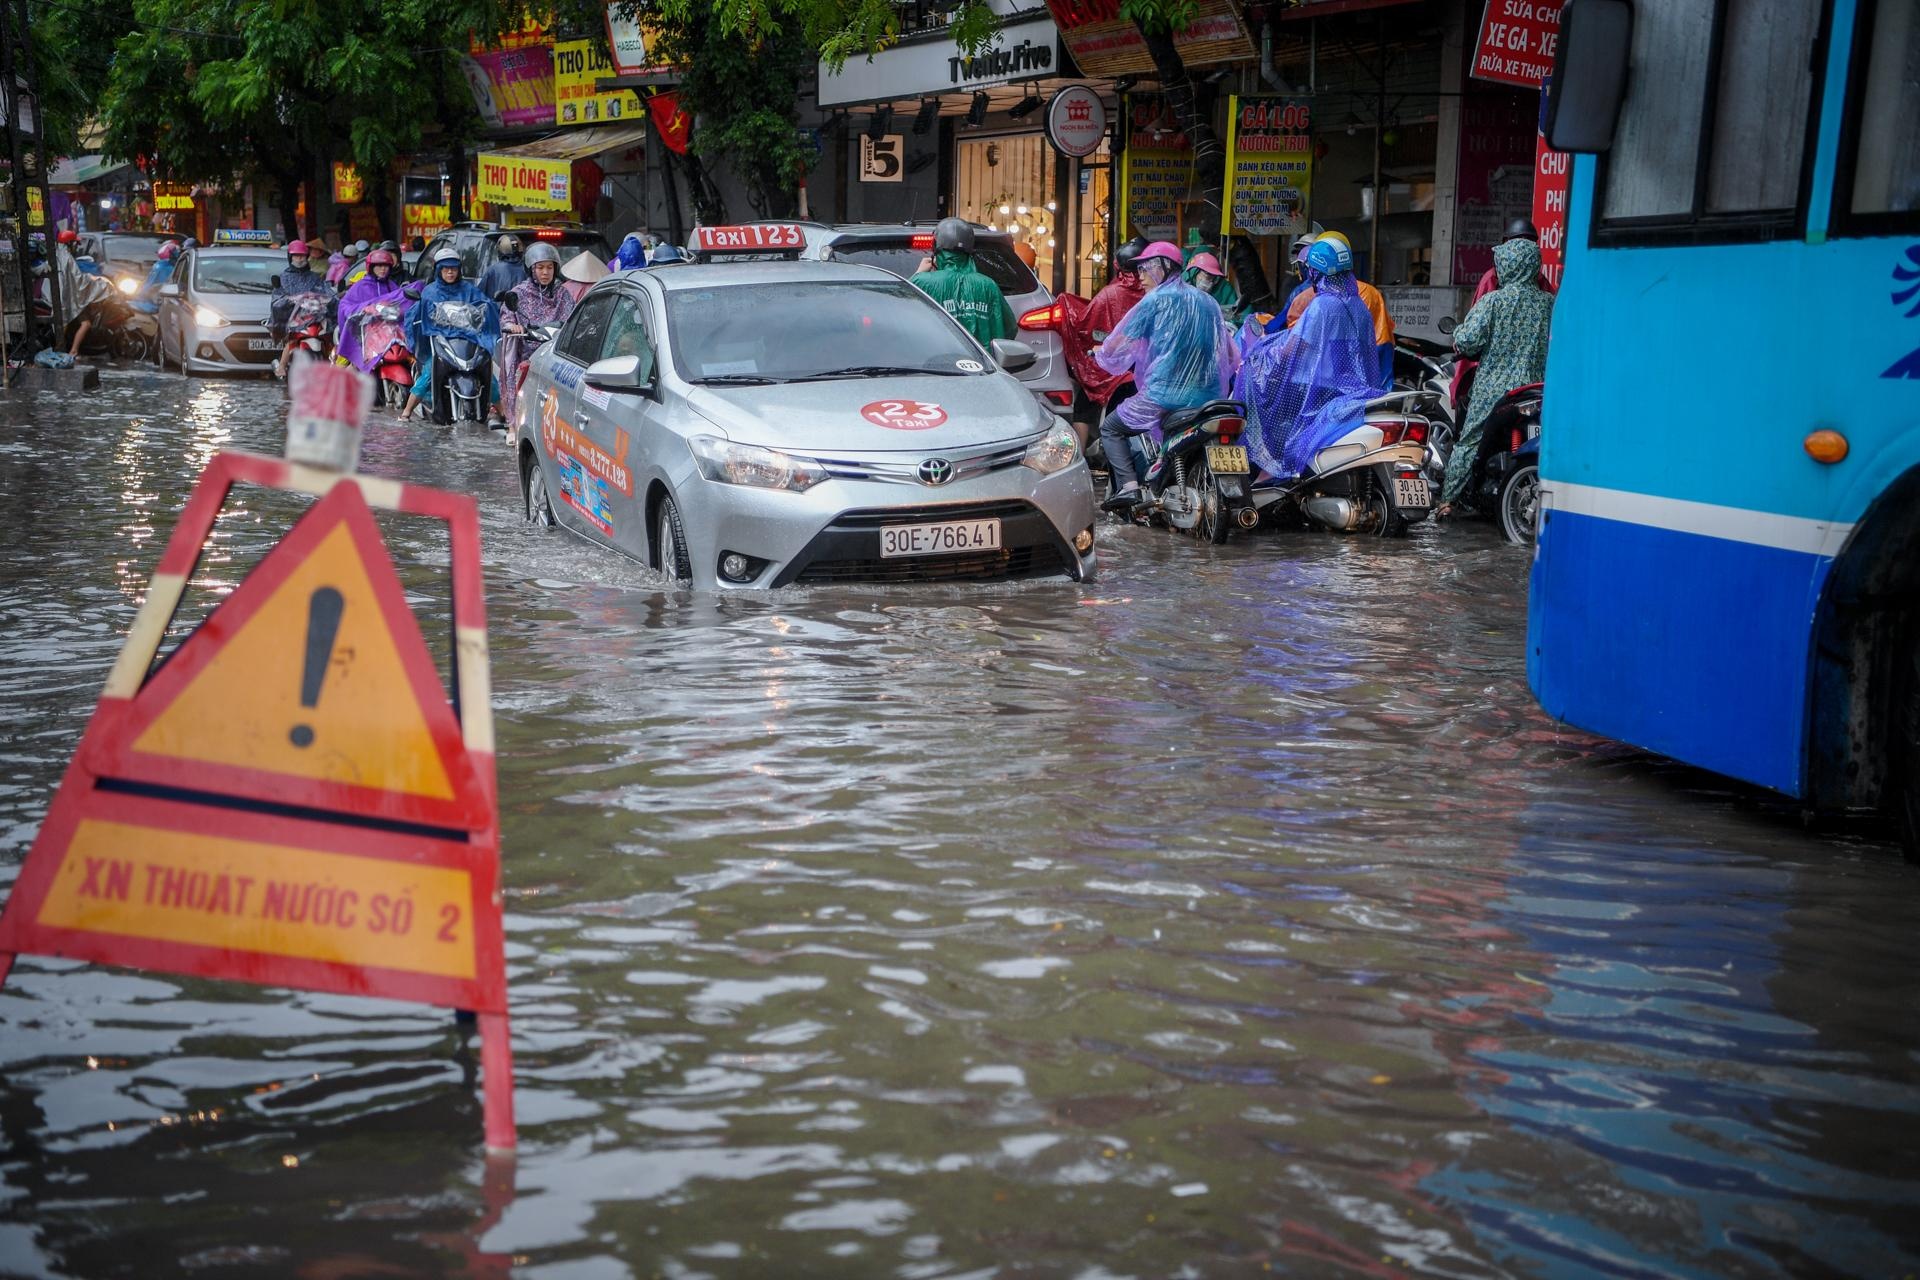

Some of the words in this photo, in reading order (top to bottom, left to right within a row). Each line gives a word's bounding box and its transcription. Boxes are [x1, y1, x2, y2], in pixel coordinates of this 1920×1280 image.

[1486, 22, 1507, 48] XE
[1508, 27, 1528, 52] GA
[1480, 52, 1502, 73] RỬA
[1504, 60, 1519, 75] XE
[484, 164, 507, 191] THỌ
[512, 162, 546, 191] LÒNG
[1277, 162, 1294, 171] NAM
[701, 227, 747, 246] Taxi
[751, 224, 800, 245] 123
[868, 401, 942, 424] 123
[892, 417, 931, 428] Taxi
[1213, 447, 1242, 459] 16-K8
[1399, 479, 1424, 492] 30-L3
[1400, 493, 1426, 505] 7836
[885, 523, 994, 553] 30E-766.41
[78, 856, 134, 902] XN
[145, 861, 255, 916] THOÁT
[262, 876, 359, 928] NƯỚC
[368, 883, 418, 935] SỐ
[437, 903, 461, 942] 2
